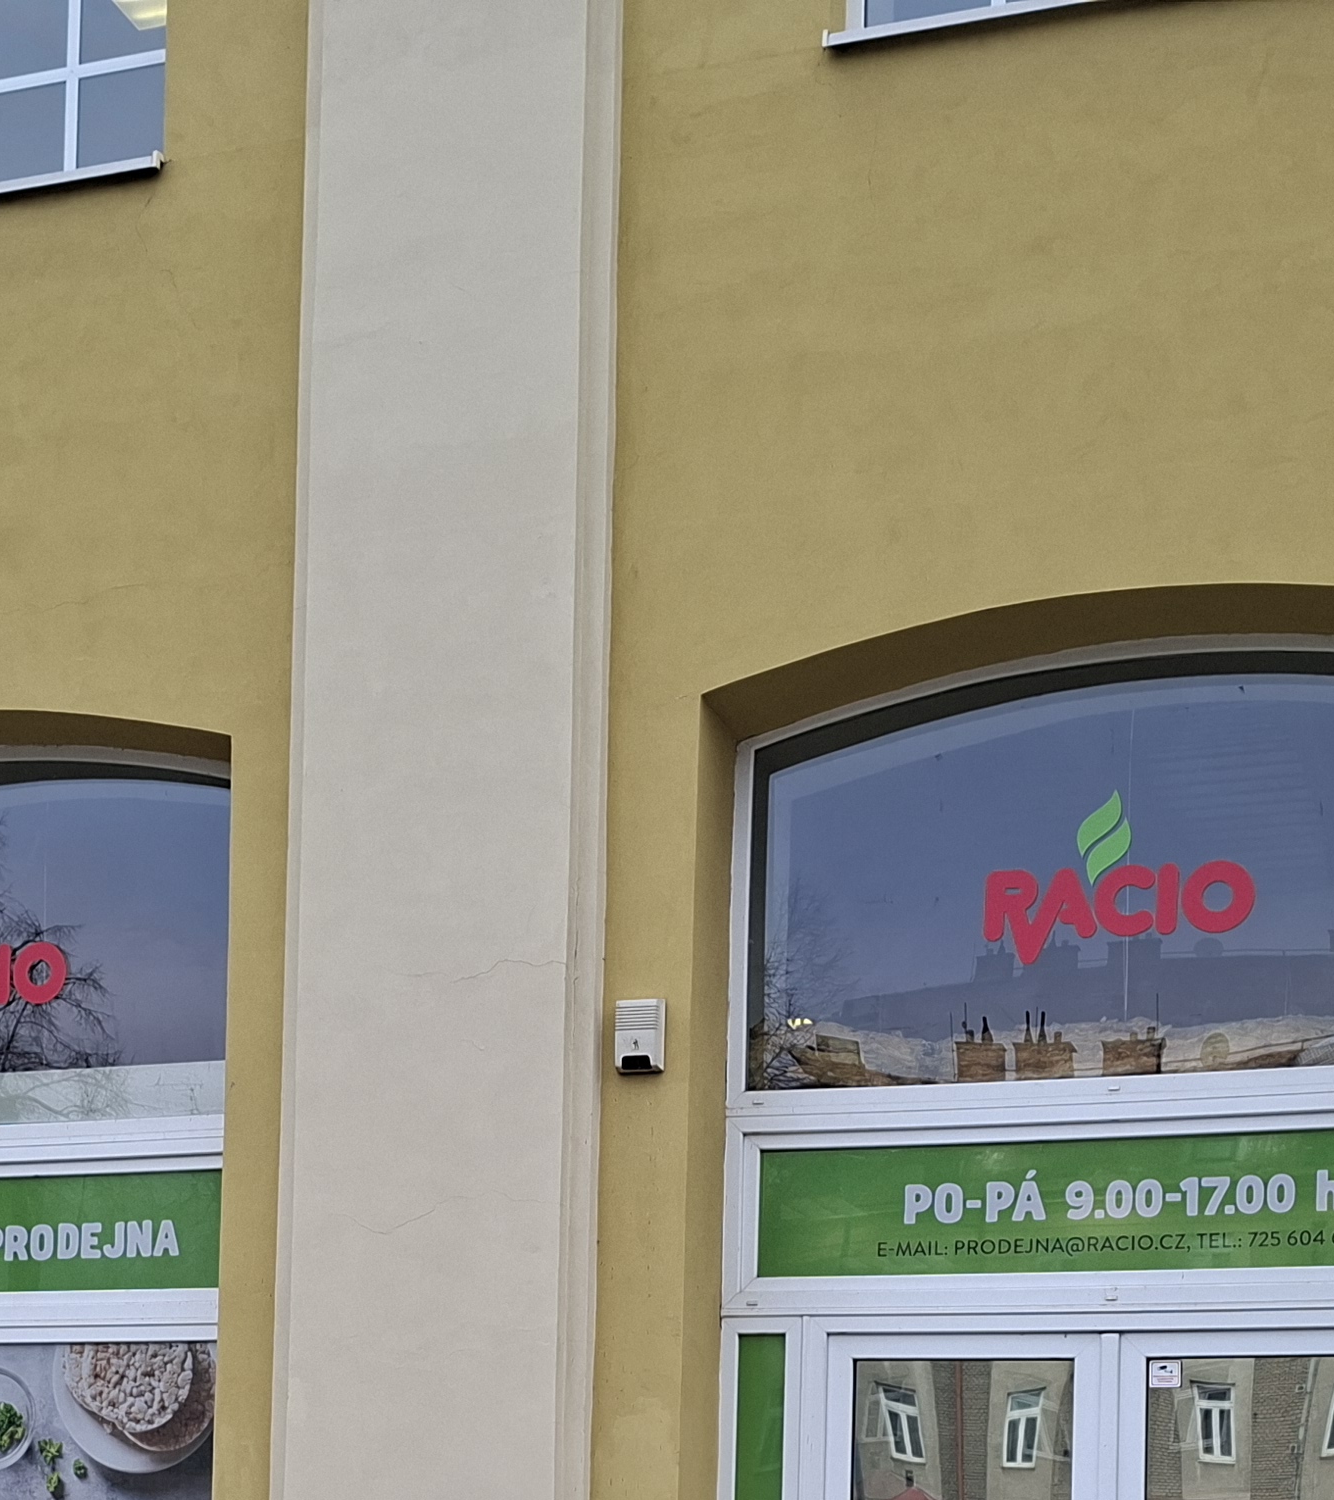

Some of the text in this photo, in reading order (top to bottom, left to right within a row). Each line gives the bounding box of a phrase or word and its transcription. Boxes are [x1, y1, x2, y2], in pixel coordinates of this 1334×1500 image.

[983, 860, 1256, 965] RACIO
[903, 1168, 1047, 1225] PO-PÁ
[1065, 1173, 1296, 1221] 9.00-17.00
[876, 1240, 949, 1258] E-MAIL:
[954, 1233, 1191, 1257] PRODEJNA@RACIO.CZ,
[1196, 1232, 1243, 1249] TEL.:
[1247, 1230, 1282, 1248] 725
[1287, 1228, 1326, 1247] 604
